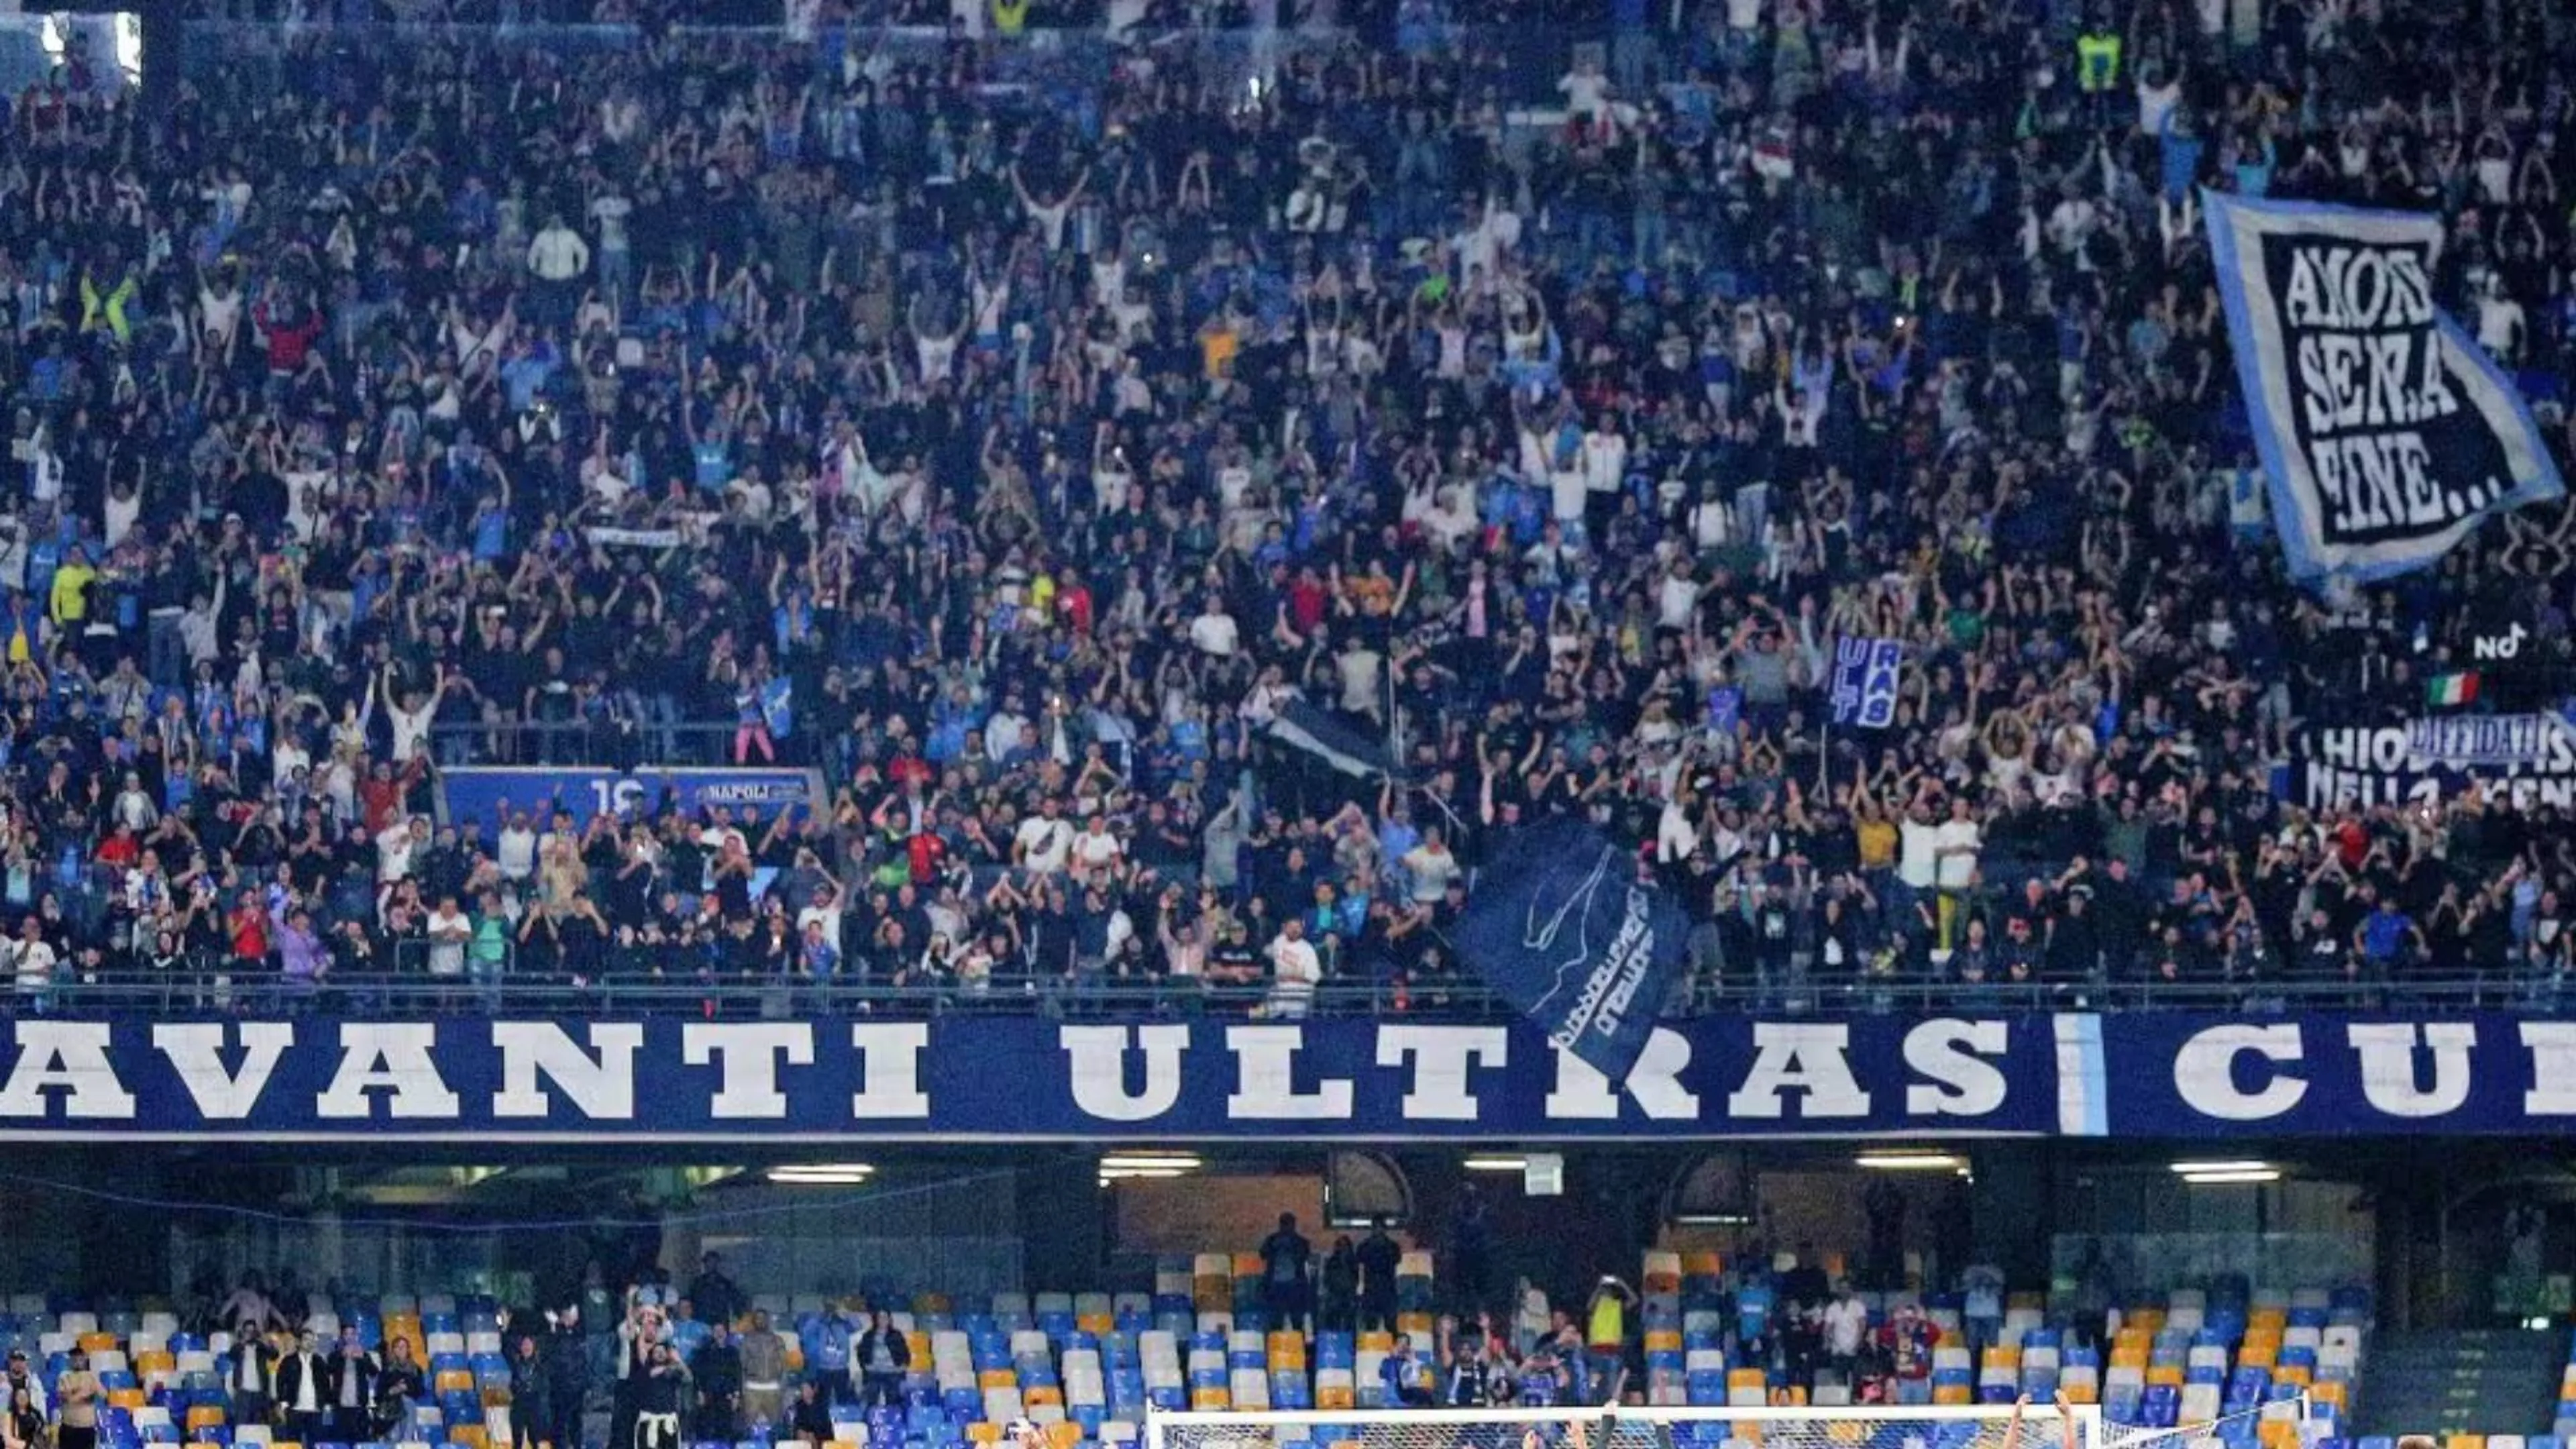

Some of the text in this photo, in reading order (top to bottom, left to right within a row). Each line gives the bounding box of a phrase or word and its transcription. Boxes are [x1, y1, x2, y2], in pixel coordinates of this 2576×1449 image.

[2412, 715, 2538, 755] DIFFIDATI
[708, 783, 769, 800] NAPOLI
[0, 1021, 930, 1118] AVANTI
[1060, 1019, 2008, 1121] ULTRAS
